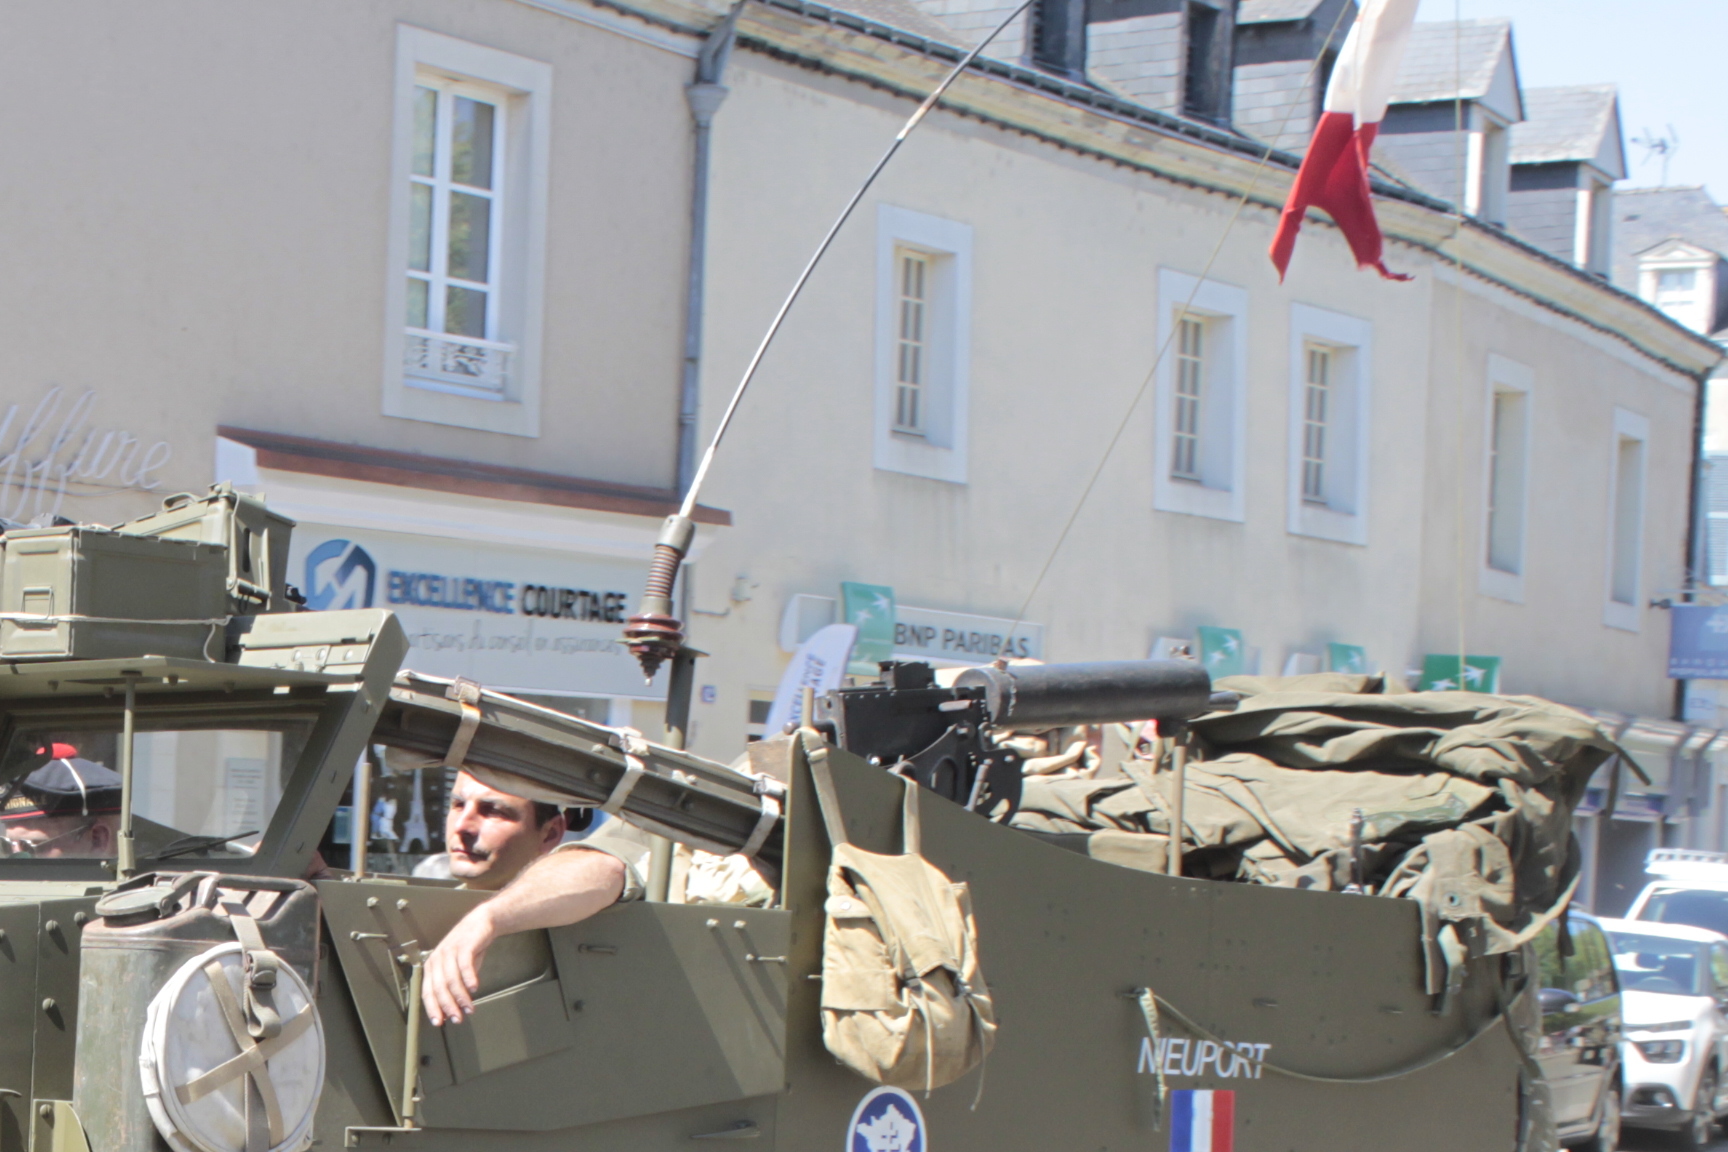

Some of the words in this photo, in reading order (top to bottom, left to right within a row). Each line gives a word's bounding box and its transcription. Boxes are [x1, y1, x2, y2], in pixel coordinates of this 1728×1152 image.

[387, 570, 514, 614] EXCELLENCE
[522, 584, 627, 623] COURTAGE
[894, 623, 936, 647] BNP
[943, 629, 1029, 658] PARIBAS
[1137, 1036, 1272, 1079] NIEUPORT
